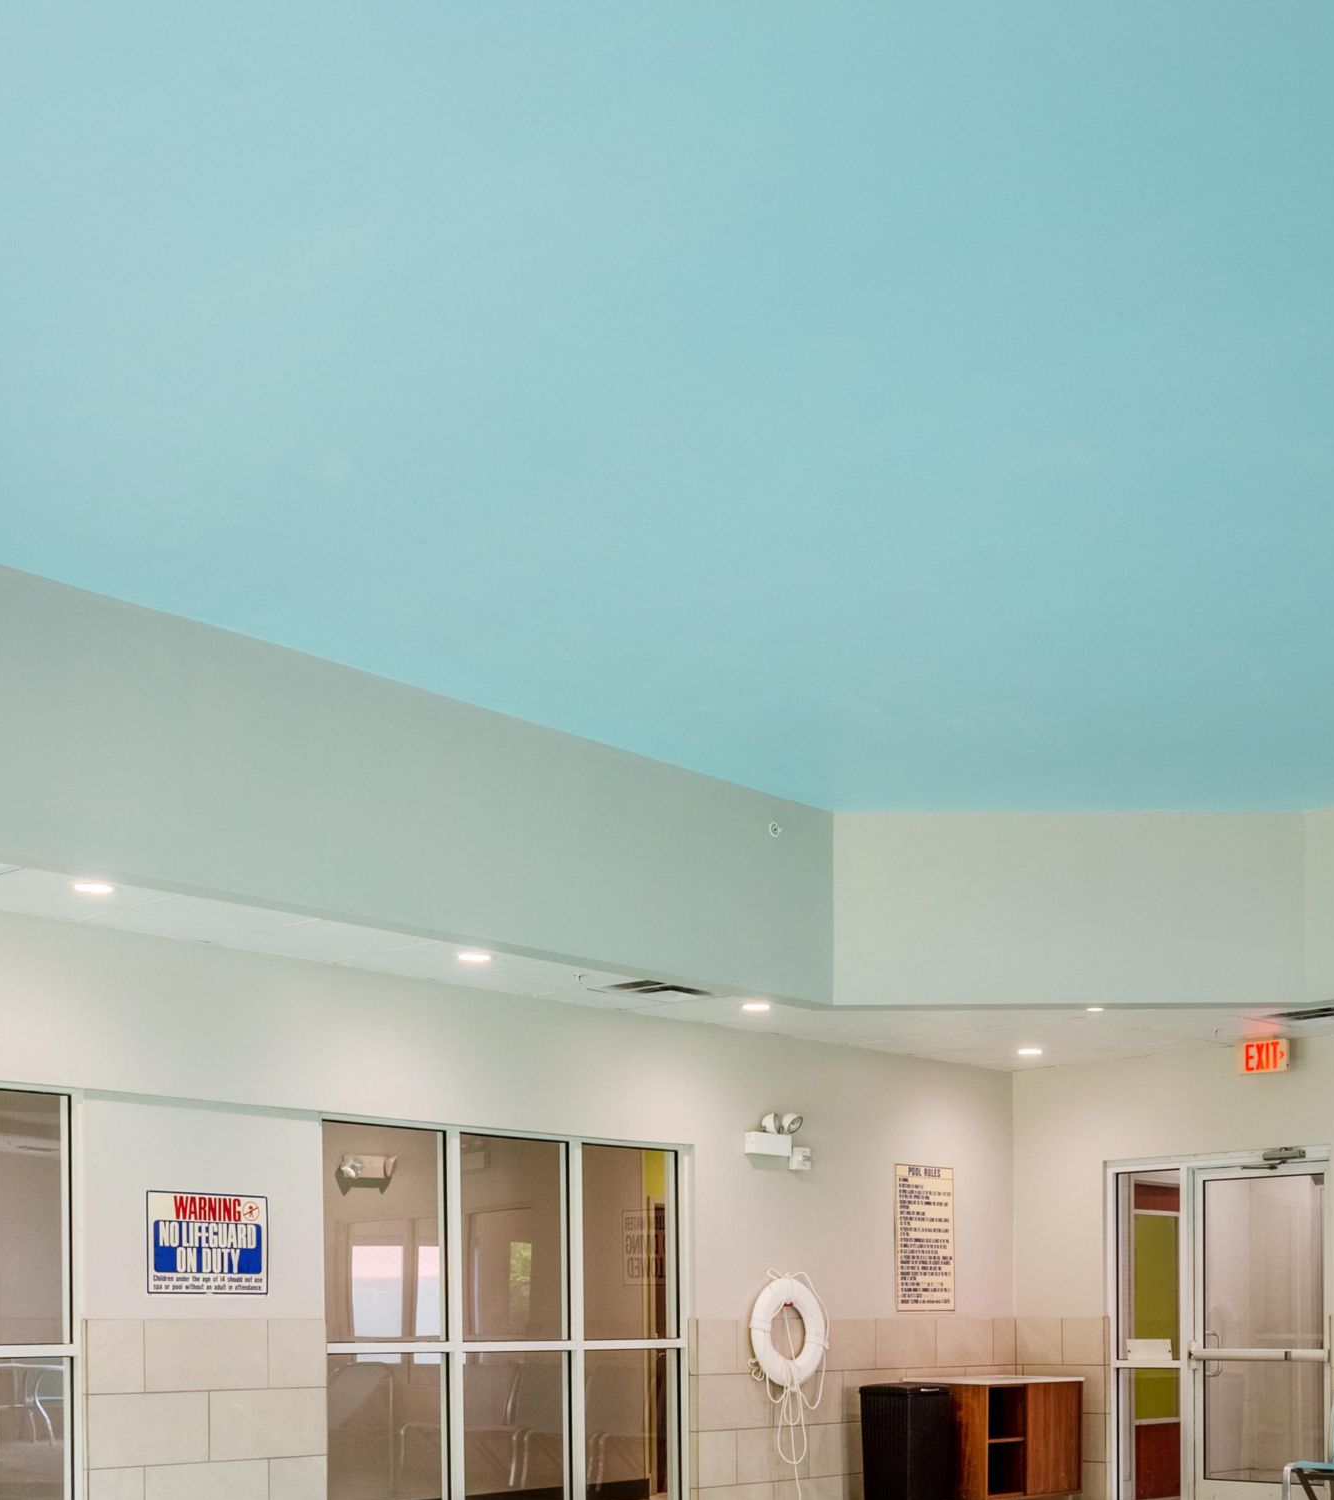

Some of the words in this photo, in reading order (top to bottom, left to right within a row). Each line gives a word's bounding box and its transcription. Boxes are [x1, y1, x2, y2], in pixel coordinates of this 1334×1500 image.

[1245, 1041, 1279, 1072] EXIT
[908, 1166, 922, 1177] POOL
[924, 1168, 941, 1178] RULES
[173, 1195, 242, 1222] WARNING
[159, 1221, 180, 1247] NO
[181, 1222, 257, 1249] LIFEGUARD
[176, 1247, 198, 1273] ON
[202, 1248, 240, 1274] DUTY
